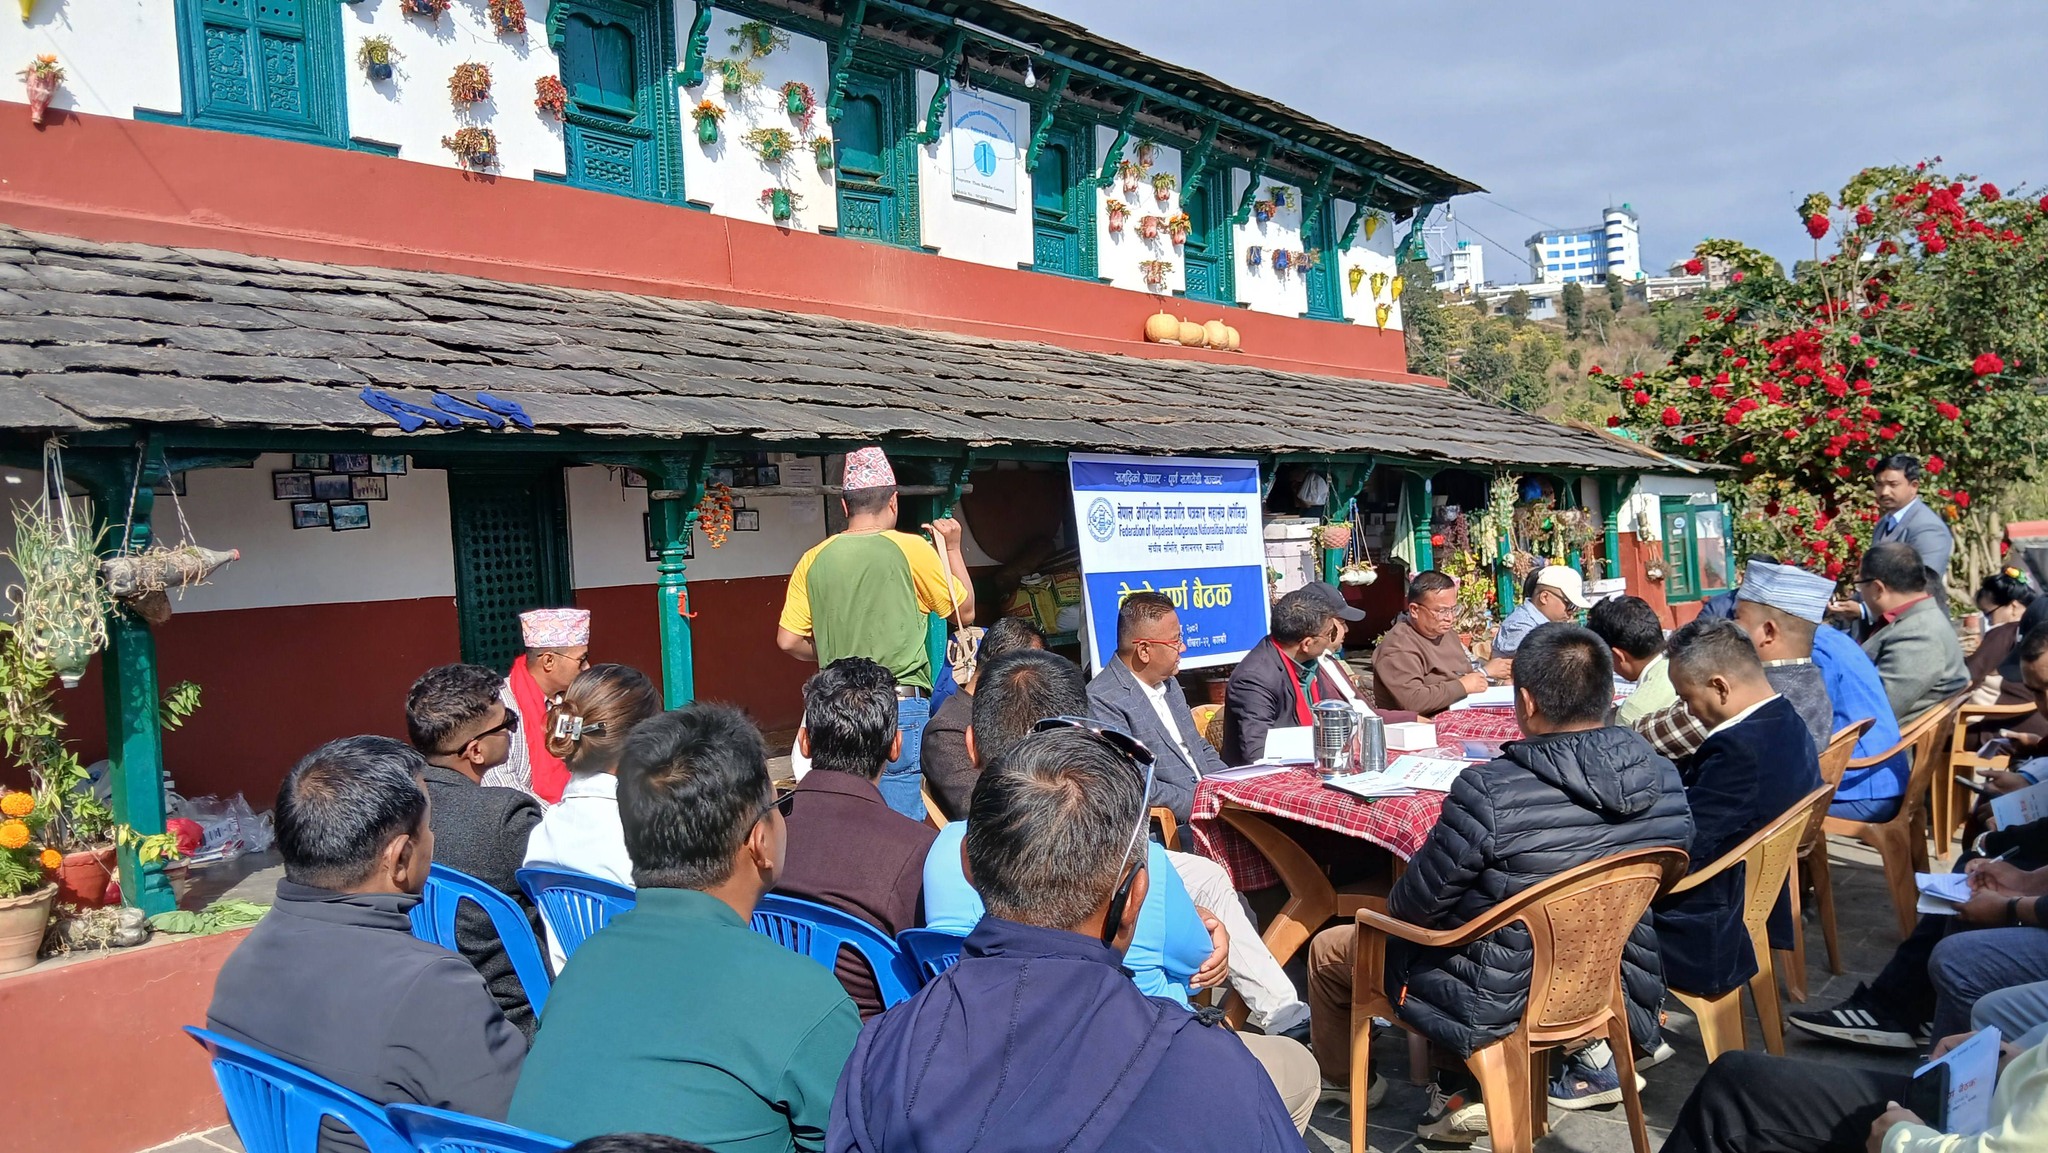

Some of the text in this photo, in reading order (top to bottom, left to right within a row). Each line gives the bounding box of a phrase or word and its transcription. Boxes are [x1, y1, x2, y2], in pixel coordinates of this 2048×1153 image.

[1117, 502, 1134, 521] नेपाल
[1187, 506, 1206, 522] पत्रकार
[1118, 523, 1146, 537] Federation
[1145, 523, 1151, 537] of
[1151, 523, 1173, 539] Nepalese
[1173, 522, 1198, 539] Indigenous
[1197, 522, 1224, 536] Nationalities
[1192, 577, 1232, 609] बैठक
